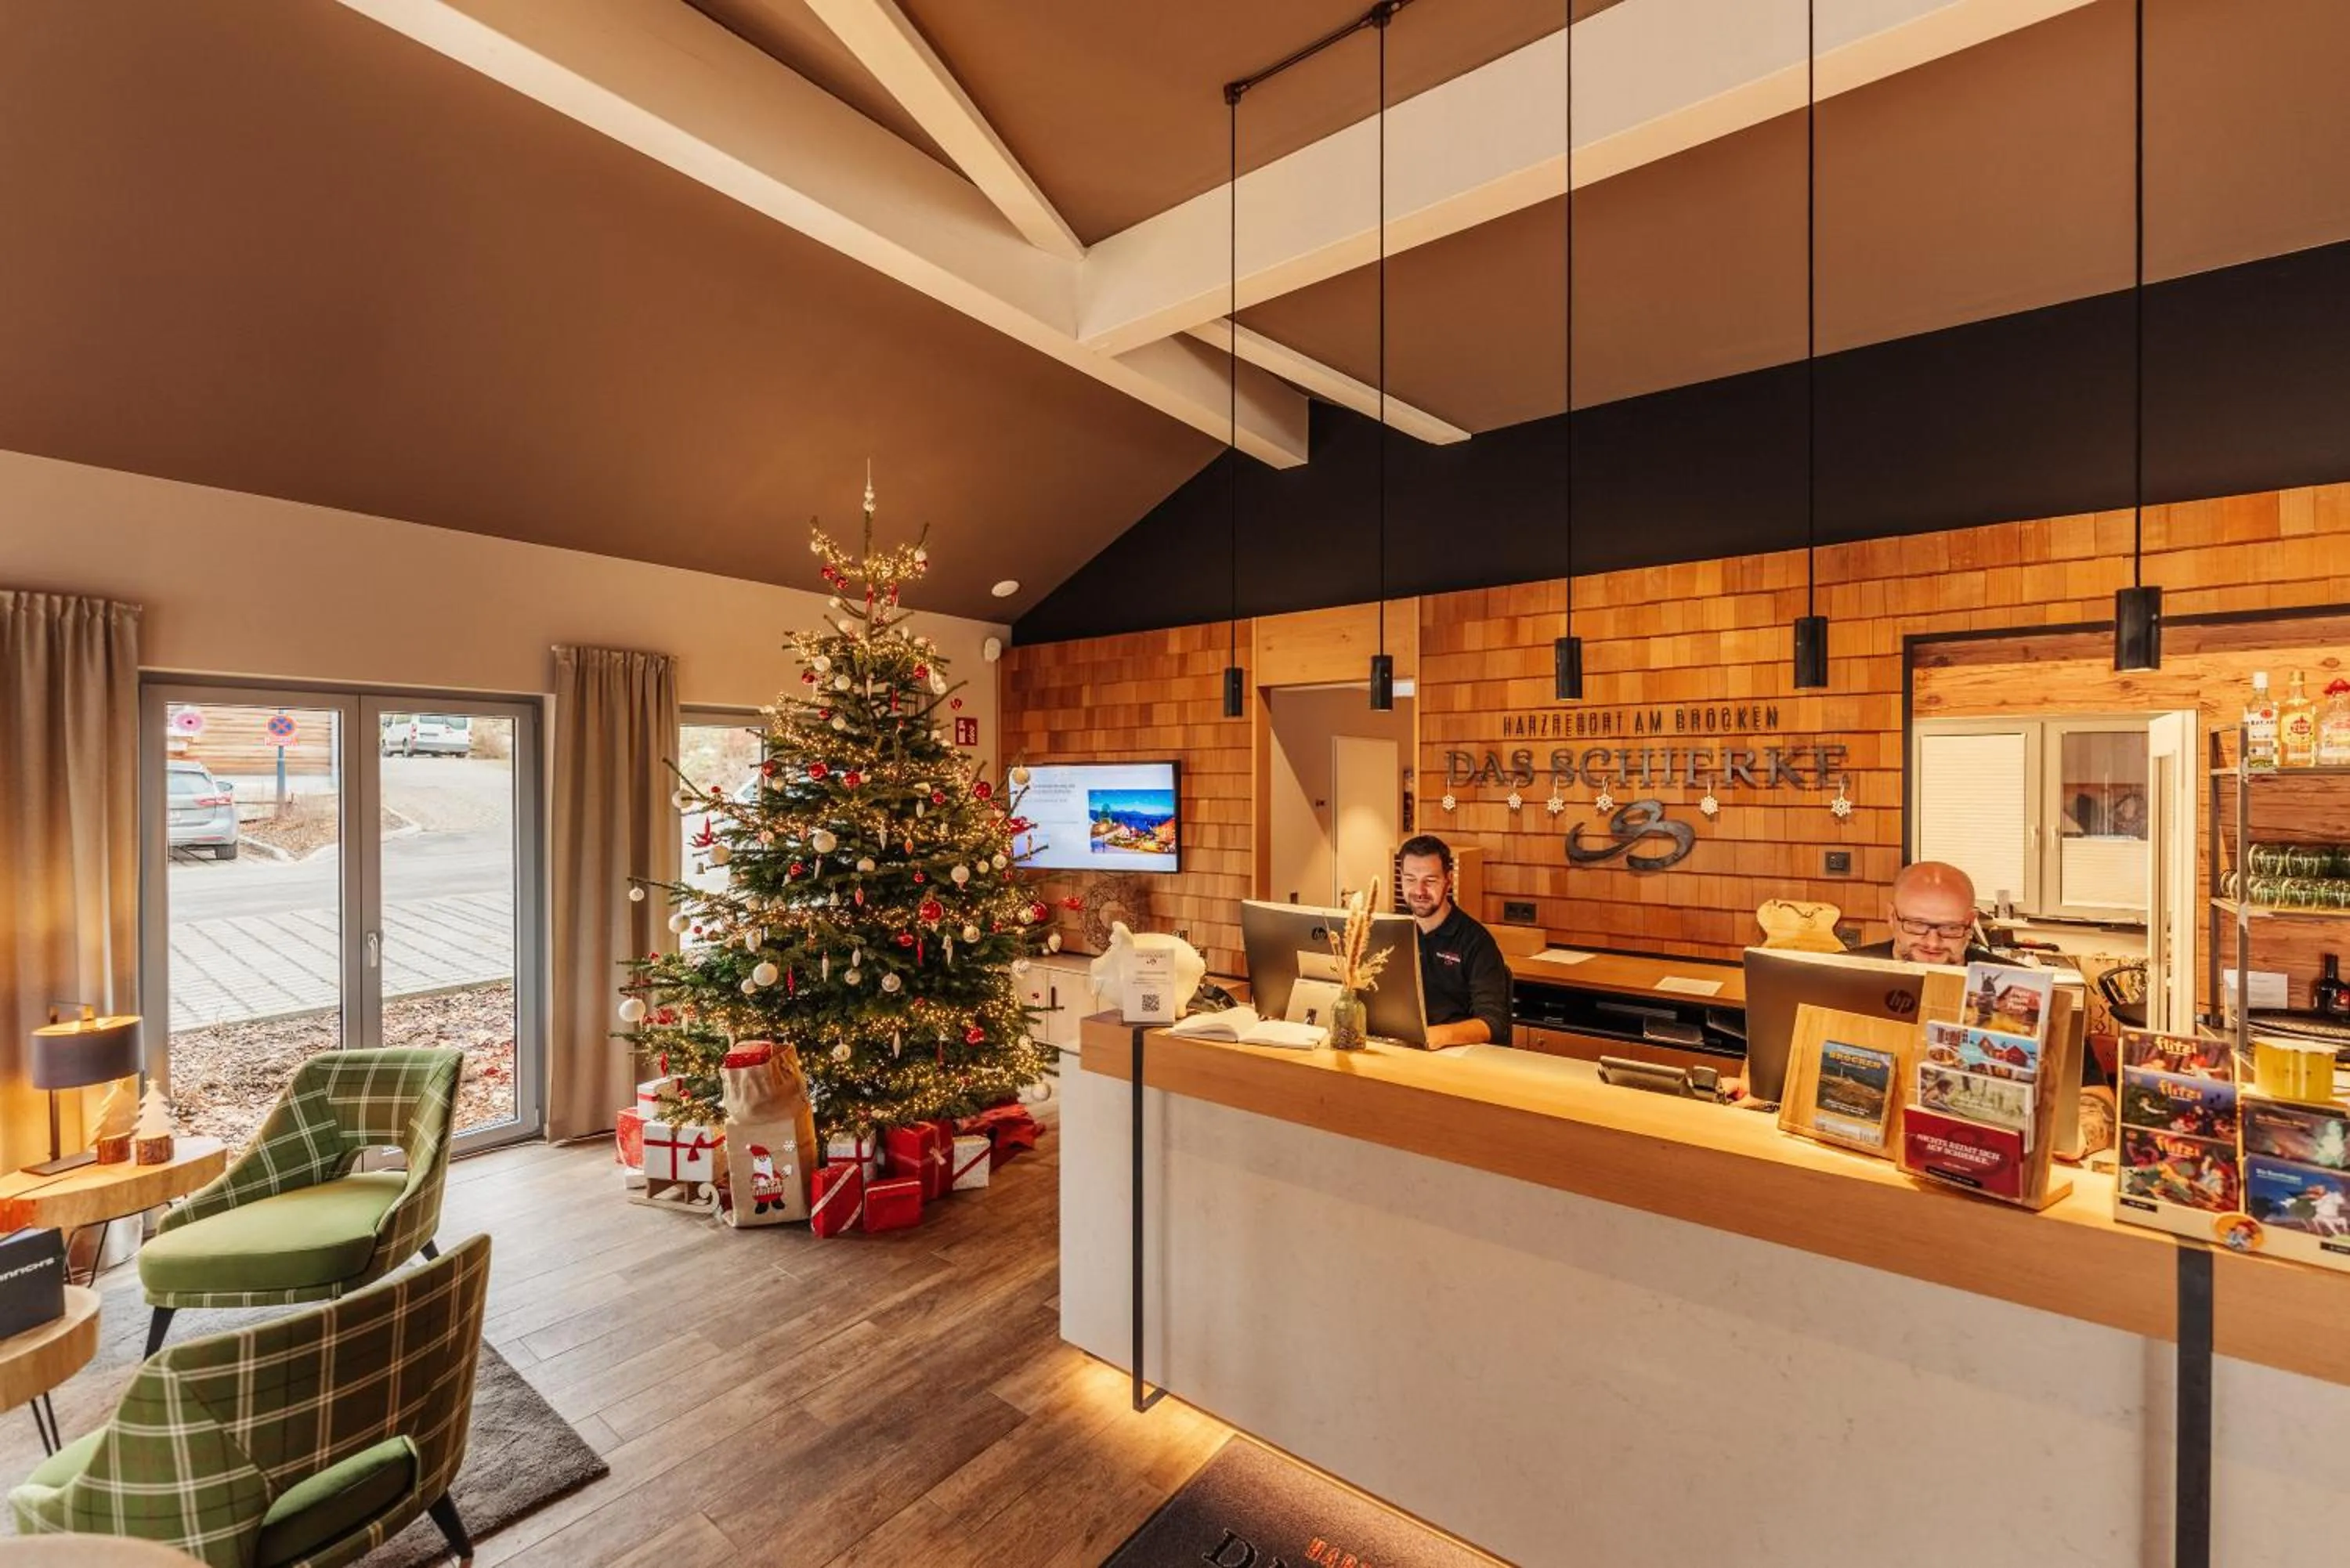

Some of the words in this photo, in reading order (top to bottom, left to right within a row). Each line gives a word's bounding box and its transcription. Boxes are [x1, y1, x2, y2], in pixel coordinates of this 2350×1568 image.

[1502, 711, 1622, 738] HARZRESORT
[1634, 710, 1662, 735] AM
[1675, 706, 1779, 734] BROCKEN
[1444, 750, 1535, 786] DAS
[1550, 744, 1852, 790] SCHIERKE
[1887, 990, 1914, 1013] hp
